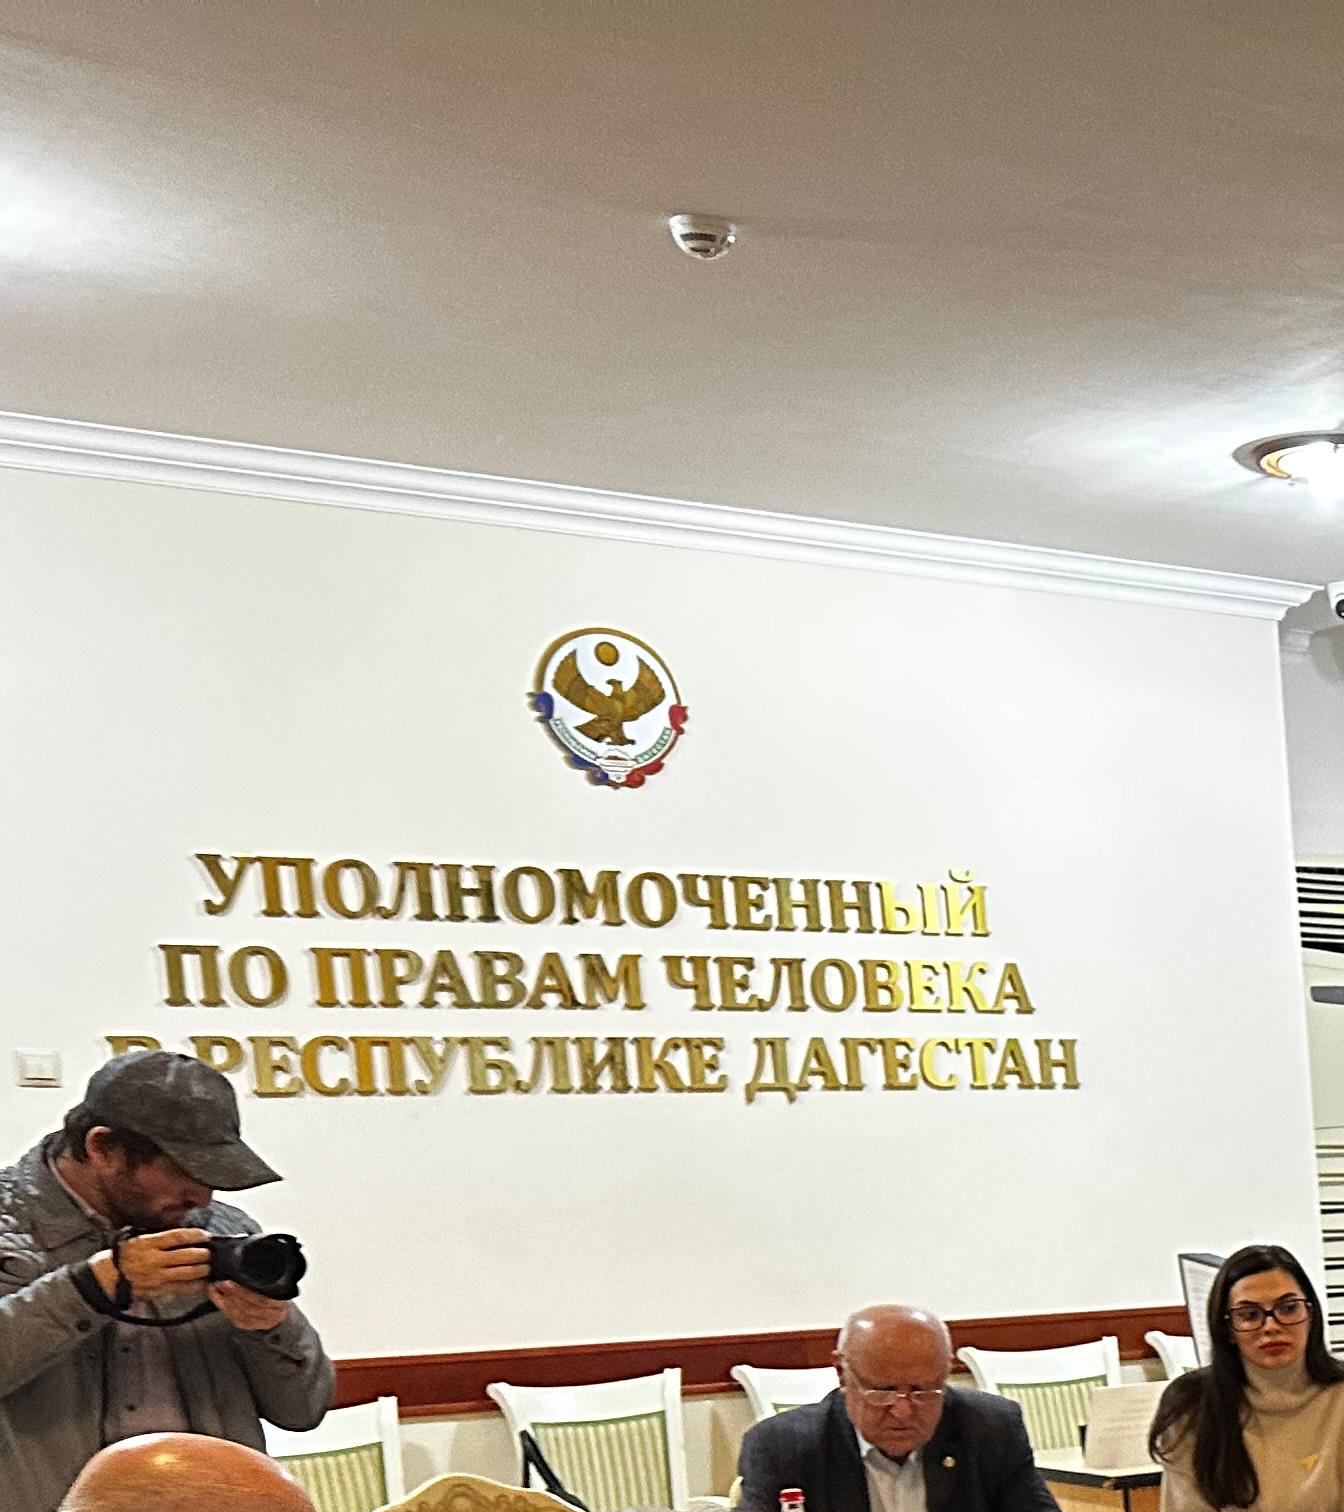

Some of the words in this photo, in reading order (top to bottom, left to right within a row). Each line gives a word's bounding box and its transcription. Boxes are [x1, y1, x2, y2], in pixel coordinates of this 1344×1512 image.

[194, 852, 990, 938] УПОЛНОМОЧЕННЫЙ
[157, 944, 289, 1008] ПО
[308, 947, 646, 1011] ПРАВАМ
[661, 954, 1036, 1015] ЧЕЛОВЕКА
[188, 1035, 728, 1099] РЕСПУБЛИКЕ
[744, 1036, 1081, 1105] ДАГЕСТАН
